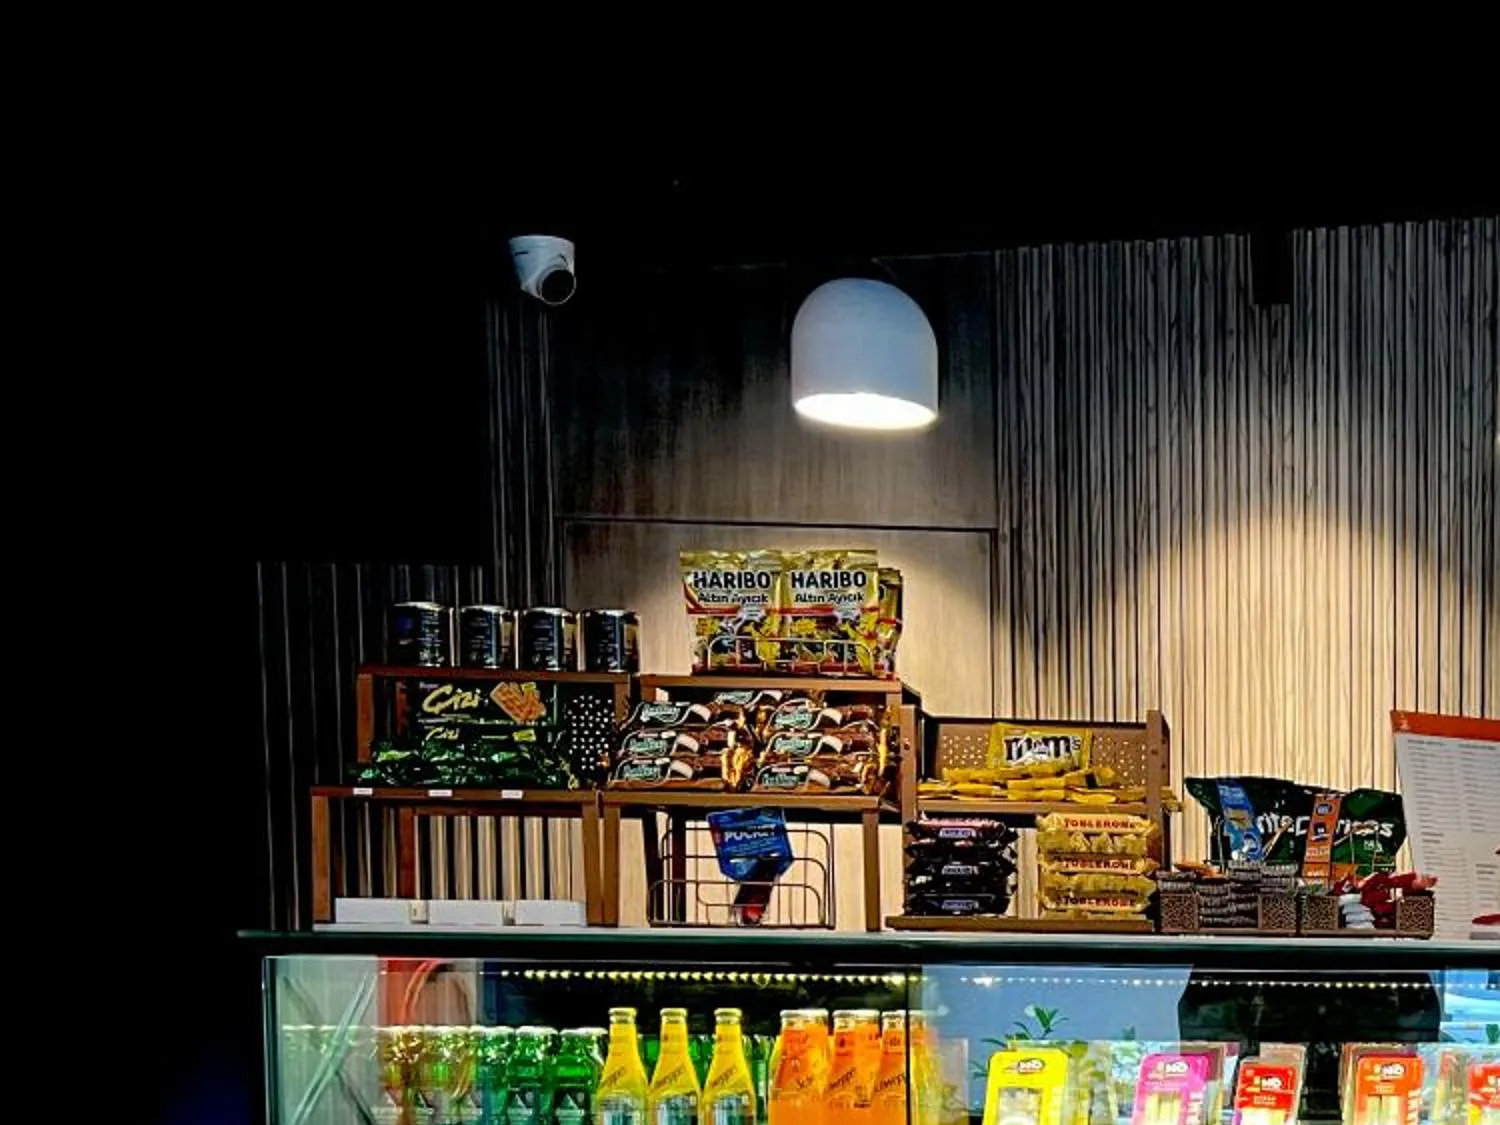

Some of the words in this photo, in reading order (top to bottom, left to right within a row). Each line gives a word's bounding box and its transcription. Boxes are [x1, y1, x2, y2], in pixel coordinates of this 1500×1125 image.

[693, 571, 771, 589] HARIBO
[791, 570, 867, 589] HARIBO
[1063, 859, 1137, 871] TOBLERONE
[1063, 897, 1136, 908] TOBLERONE
